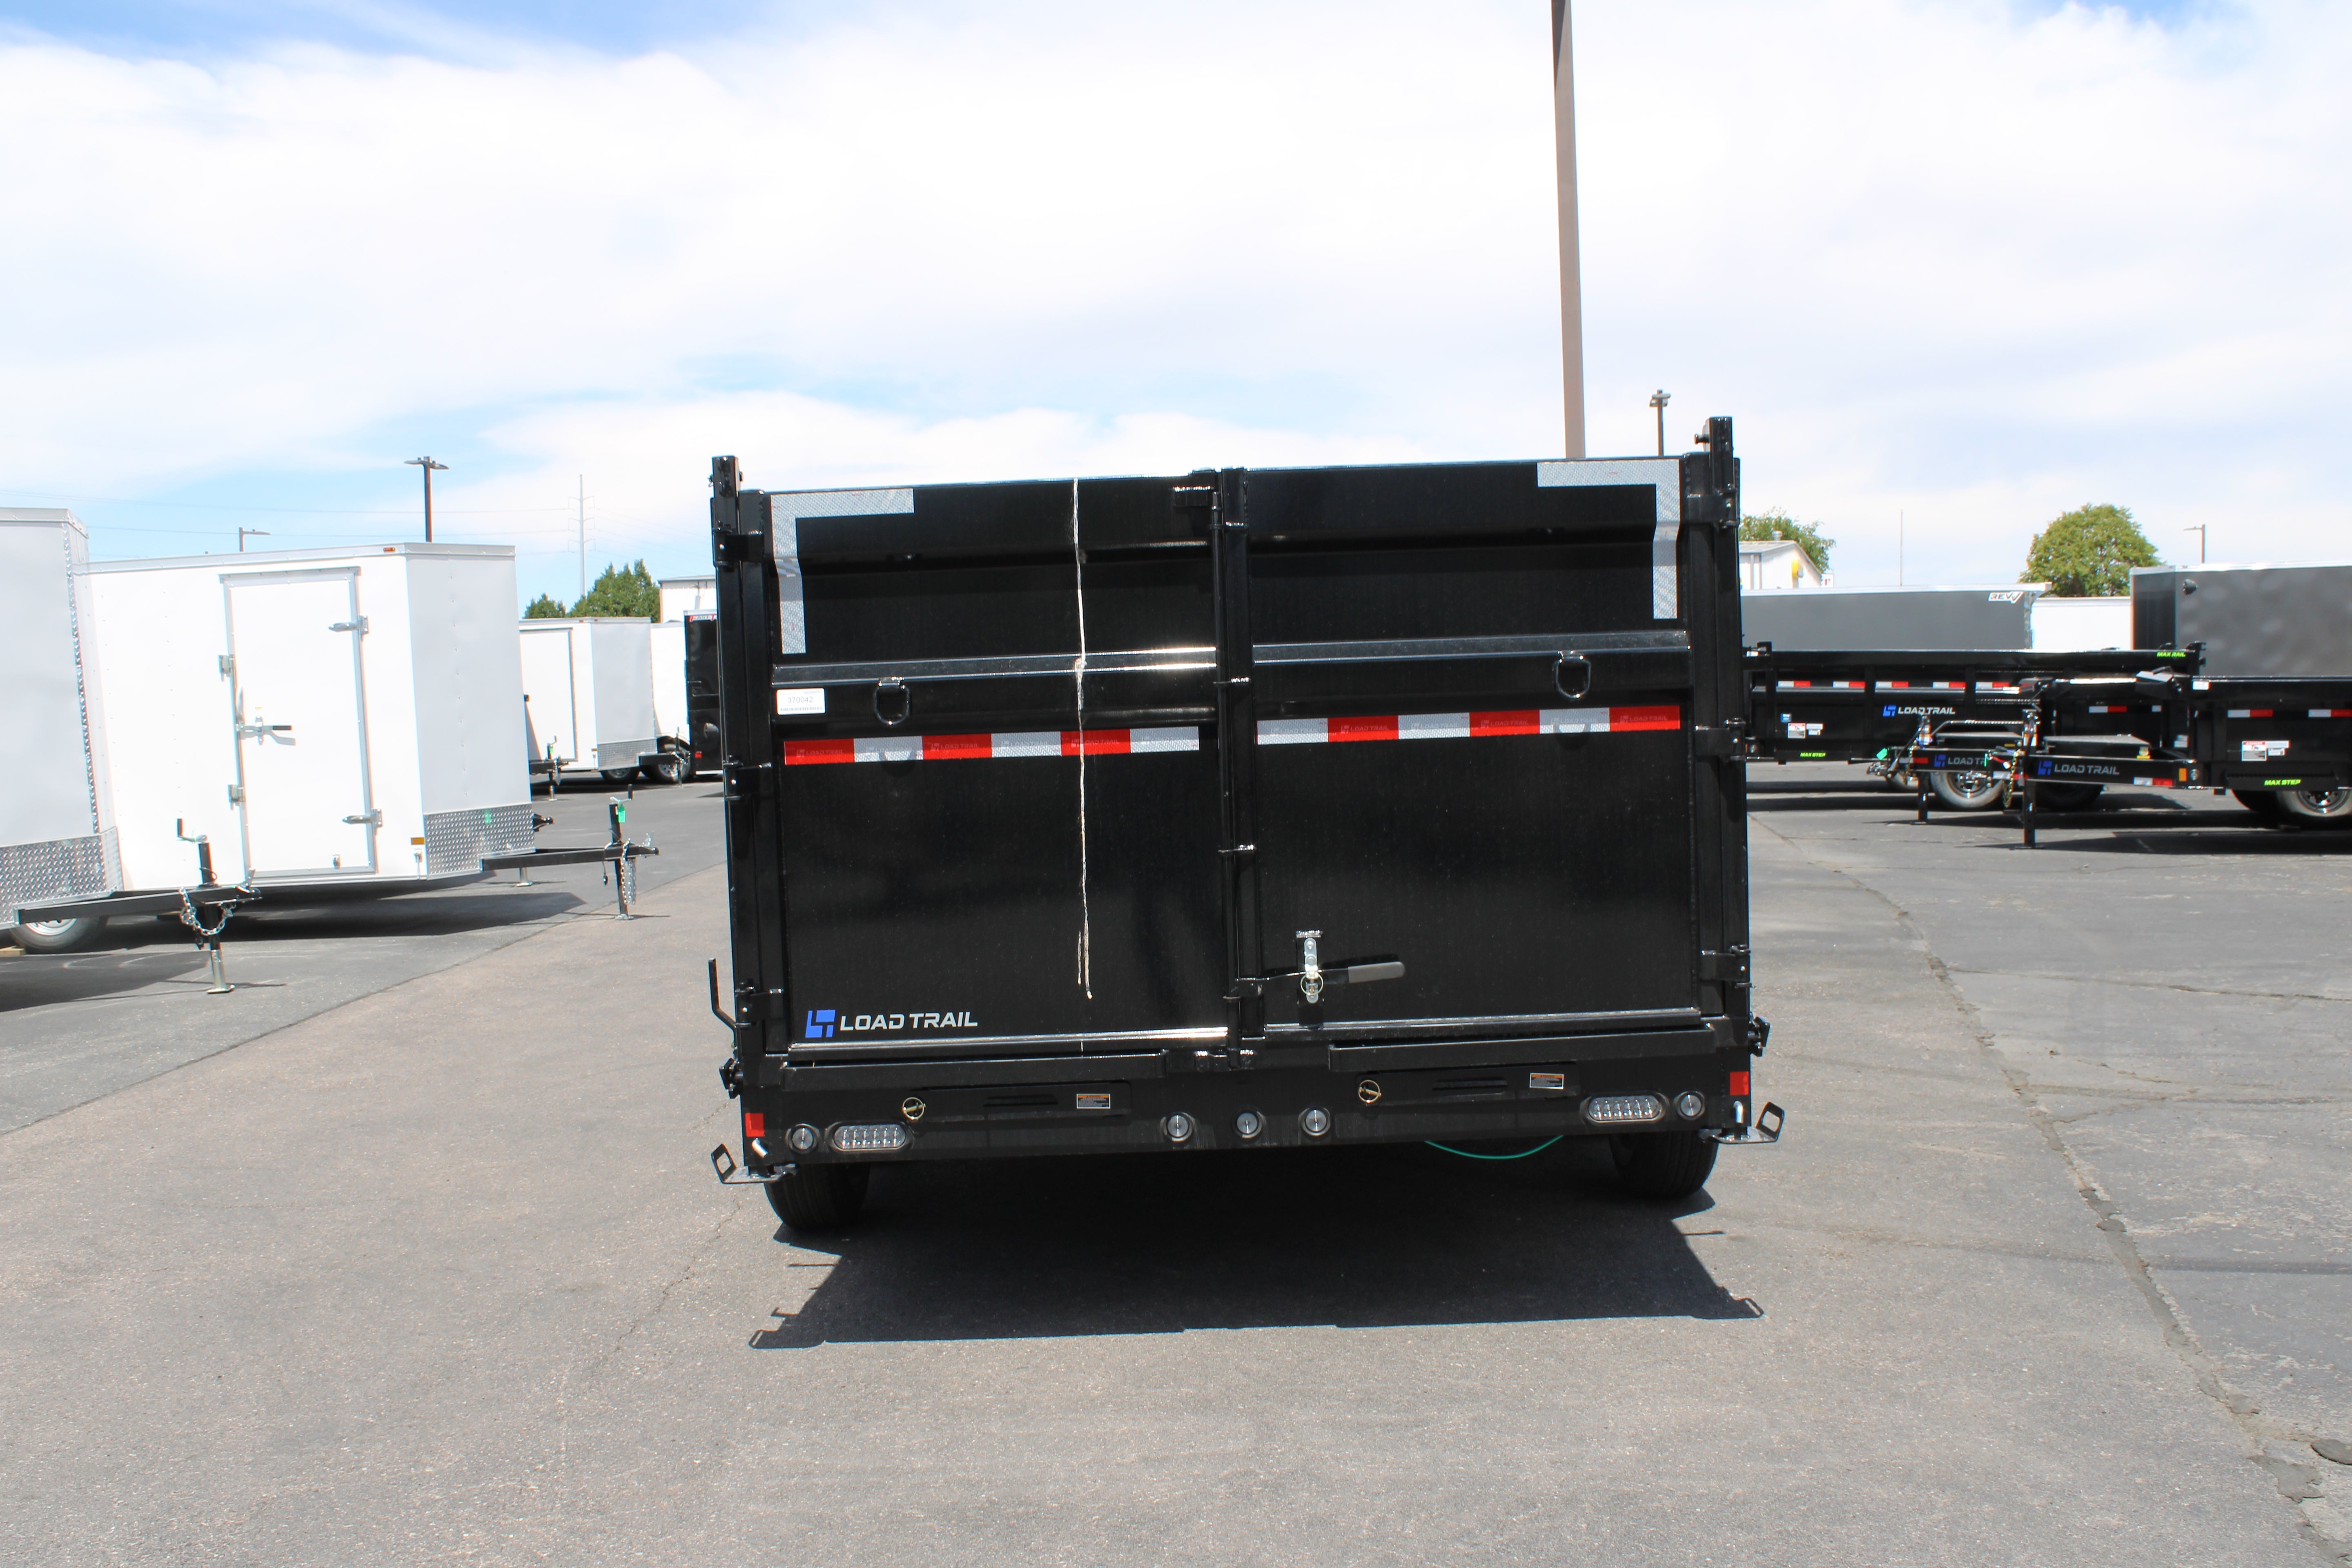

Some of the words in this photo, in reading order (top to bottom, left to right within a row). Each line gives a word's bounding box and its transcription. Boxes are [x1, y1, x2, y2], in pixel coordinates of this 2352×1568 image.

[787, 696, 813, 704] 370042
[1898, 706, 1924, 715] LOAD
[1927, 706, 1956, 715] TRAIL
[1947, 757, 1973, 765] LOAD
[2054, 764, 2085, 773] LOAD
[2087, 765, 2120, 775] TRAIL
[840, 1013, 905, 1031] LOAD
[909, 1011, 978, 1029] TRAIL
